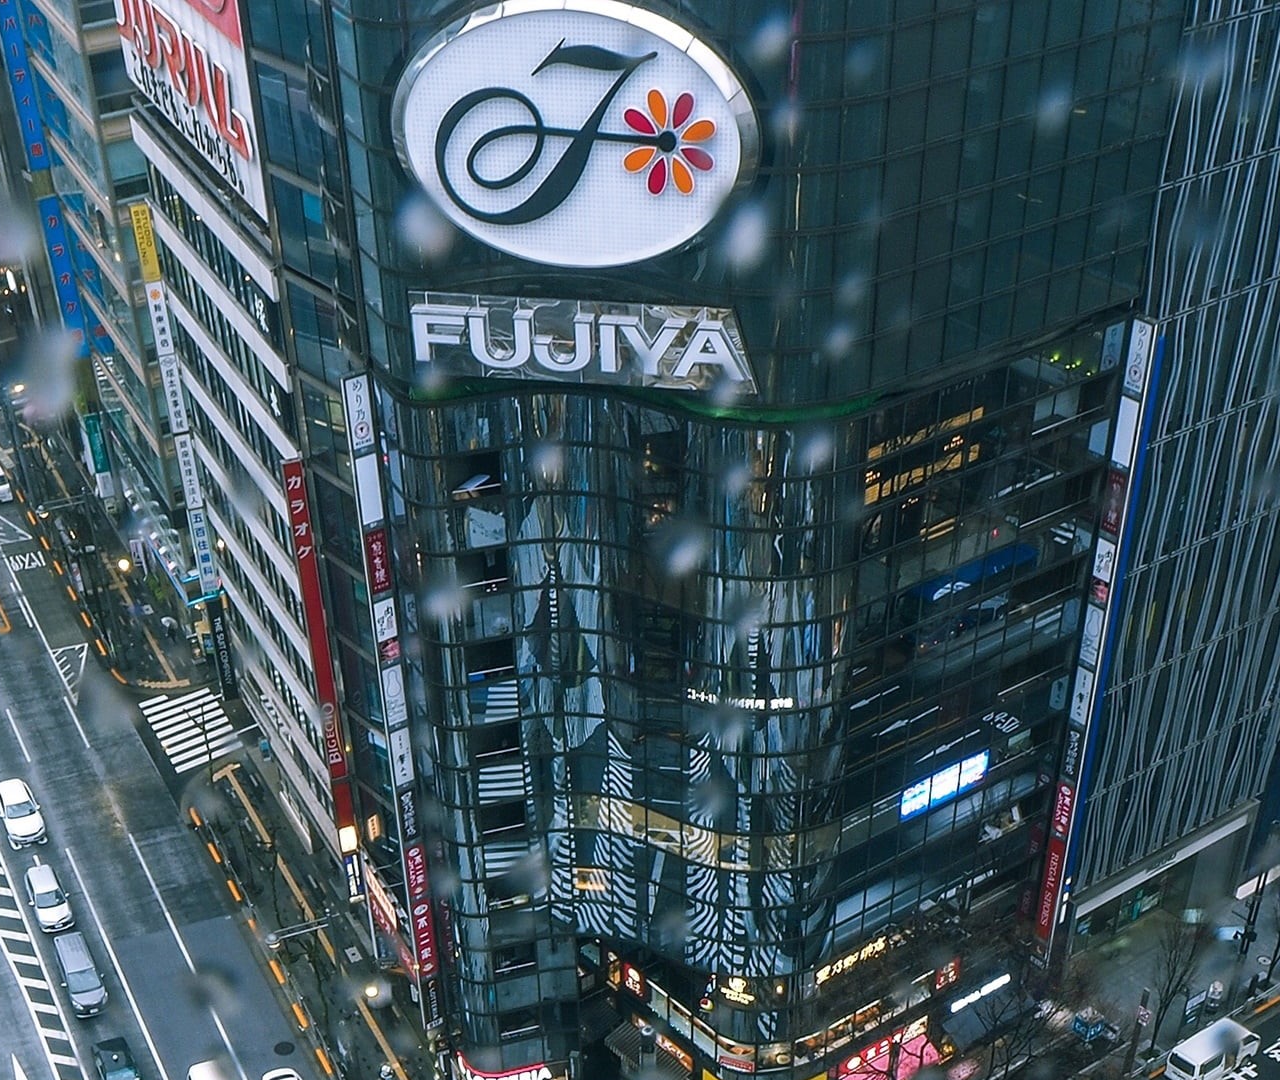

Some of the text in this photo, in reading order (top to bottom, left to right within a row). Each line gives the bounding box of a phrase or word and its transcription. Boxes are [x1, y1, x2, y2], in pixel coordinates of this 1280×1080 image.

[408, 303, 749, 382] FUJIYA
[287, 475, 312, 560] カラオケ
[1040, 851, 1060, 928] REGAL SHOES
[416, 917, 434, 961] 不二家
